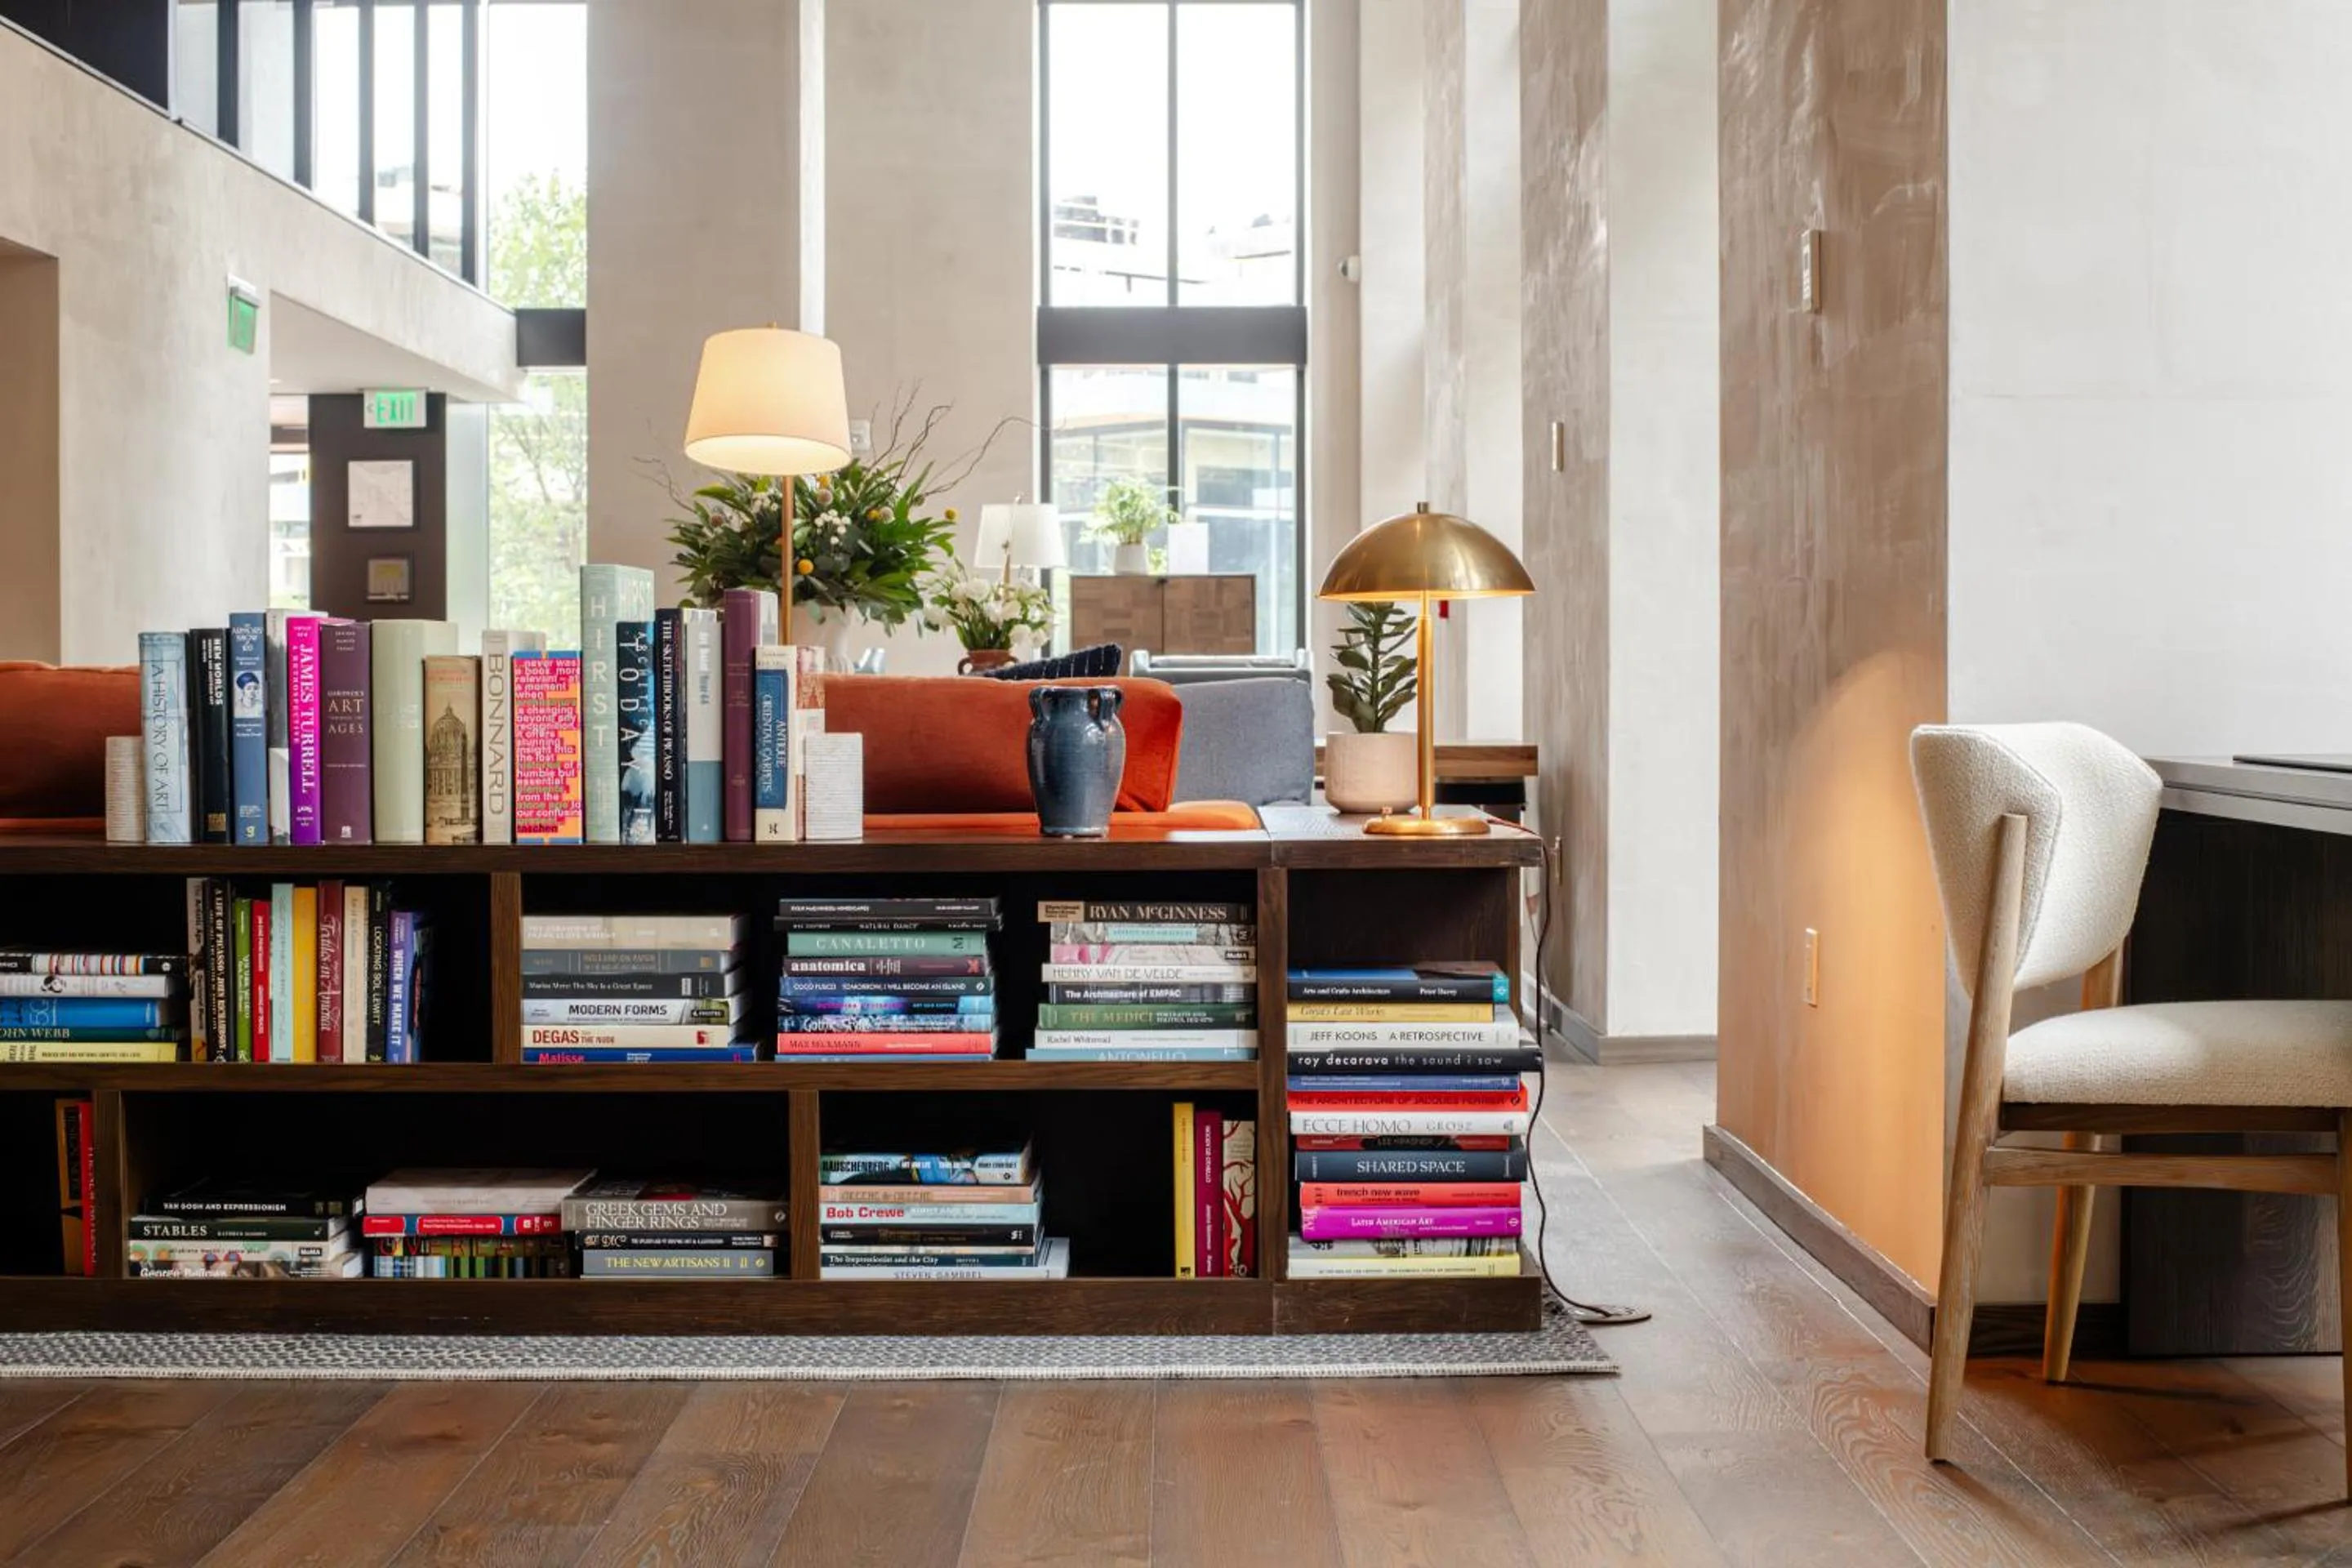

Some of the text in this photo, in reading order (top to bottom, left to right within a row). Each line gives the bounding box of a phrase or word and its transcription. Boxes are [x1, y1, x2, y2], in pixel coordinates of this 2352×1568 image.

[375, 392, 416, 424] EXIT
[662, 618, 672, 641] THE
[213, 638, 224, 706] NEW WORLDS
[300, 644, 314, 702] JAMES
[590, 594, 607, 747] HIRST
[662, 643, 673, 719] SKETCHBOOKS
[328, 699, 364, 712] ART
[619, 638, 639, 771] TODAY
[152, 681, 167, 749] HISTORY
[328, 723, 364, 733] AGES
[663, 721, 673, 733] OF
[488, 656, 504, 815] BONNARD
[761, 693, 773, 792] ORIENTAL CARPETS
[775, 718, 786, 768] ANTIQUE
[301, 706, 318, 795] TURRELL
[154, 752, 168, 774] OF
[662, 737, 673, 781] PICASSO
[154, 778, 169, 810] ART
[517, 825, 558, 834] taschen
[215, 897, 223, 915] LIFE
[1089, 906, 1129, 919] RYAN
[1137, 905, 1227, 920] McGINNESS
[216, 919, 224, 931] OF
[817, 938, 925, 949] CANALETTO
[215, 933, 225, 972] PICASSO
[393, 948, 403, 981] WHEN
[791, 961, 866, 972] anatomica
[372, 925, 382, 1026] LOCATING SOL LEWITT
[1096, 969, 1120, 978] VAN
[1125, 969, 1141, 978] DE
[1143, 969, 1183, 979] VELDE
[393, 983, 403, 1000] WE
[587, 982, 599, 991] Sky
[1083, 990, 1137, 998] Architecture
[568, 1004, 667, 1016] MODERN FORMS
[391, 1003, 402, 1032] MAKE
[1071, 1012, 1153, 1022] THE MEDICI
[0, 1028, 70, 1039] OHN WEBB
[532, 1030, 579, 1044] DEGAS
[1310, 1031, 1484, 1041] JEFF KOONS A RETROSPECTIVE
[391, 1035, 401, 1046] IT
[538, 1053, 585, 1064] Matisse
[1298, 1057, 1320, 1067] roy
[1395, 1054, 1415, 1066] the
[1423, 1054, 1460, 1066] sound
[1478, 1057, 1503, 1065] saw
[1303, 1118, 1347, 1133] ECCE
[1353, 1118, 1411, 1134] HOMO
[823, 1160, 890, 1172] RAUSCHENBERG
[1356, 1161, 1465, 1174] SHARED SPACE
[1337, 1187, 1369, 1196] french
[586, 1203, 727, 1216] GREEK GEMS AND
[826, 1207, 905, 1218] Bob Crewe
[586, 1217, 699, 1229] FINGER RINGS
[144, 1226, 207, 1236] STABLES
[605, 1258, 631, 1267] THE
[634, 1258, 662, 1267] NEW
[663, 1258, 719, 1267] ARTISANS
[923, 1256, 938, 1265] City
